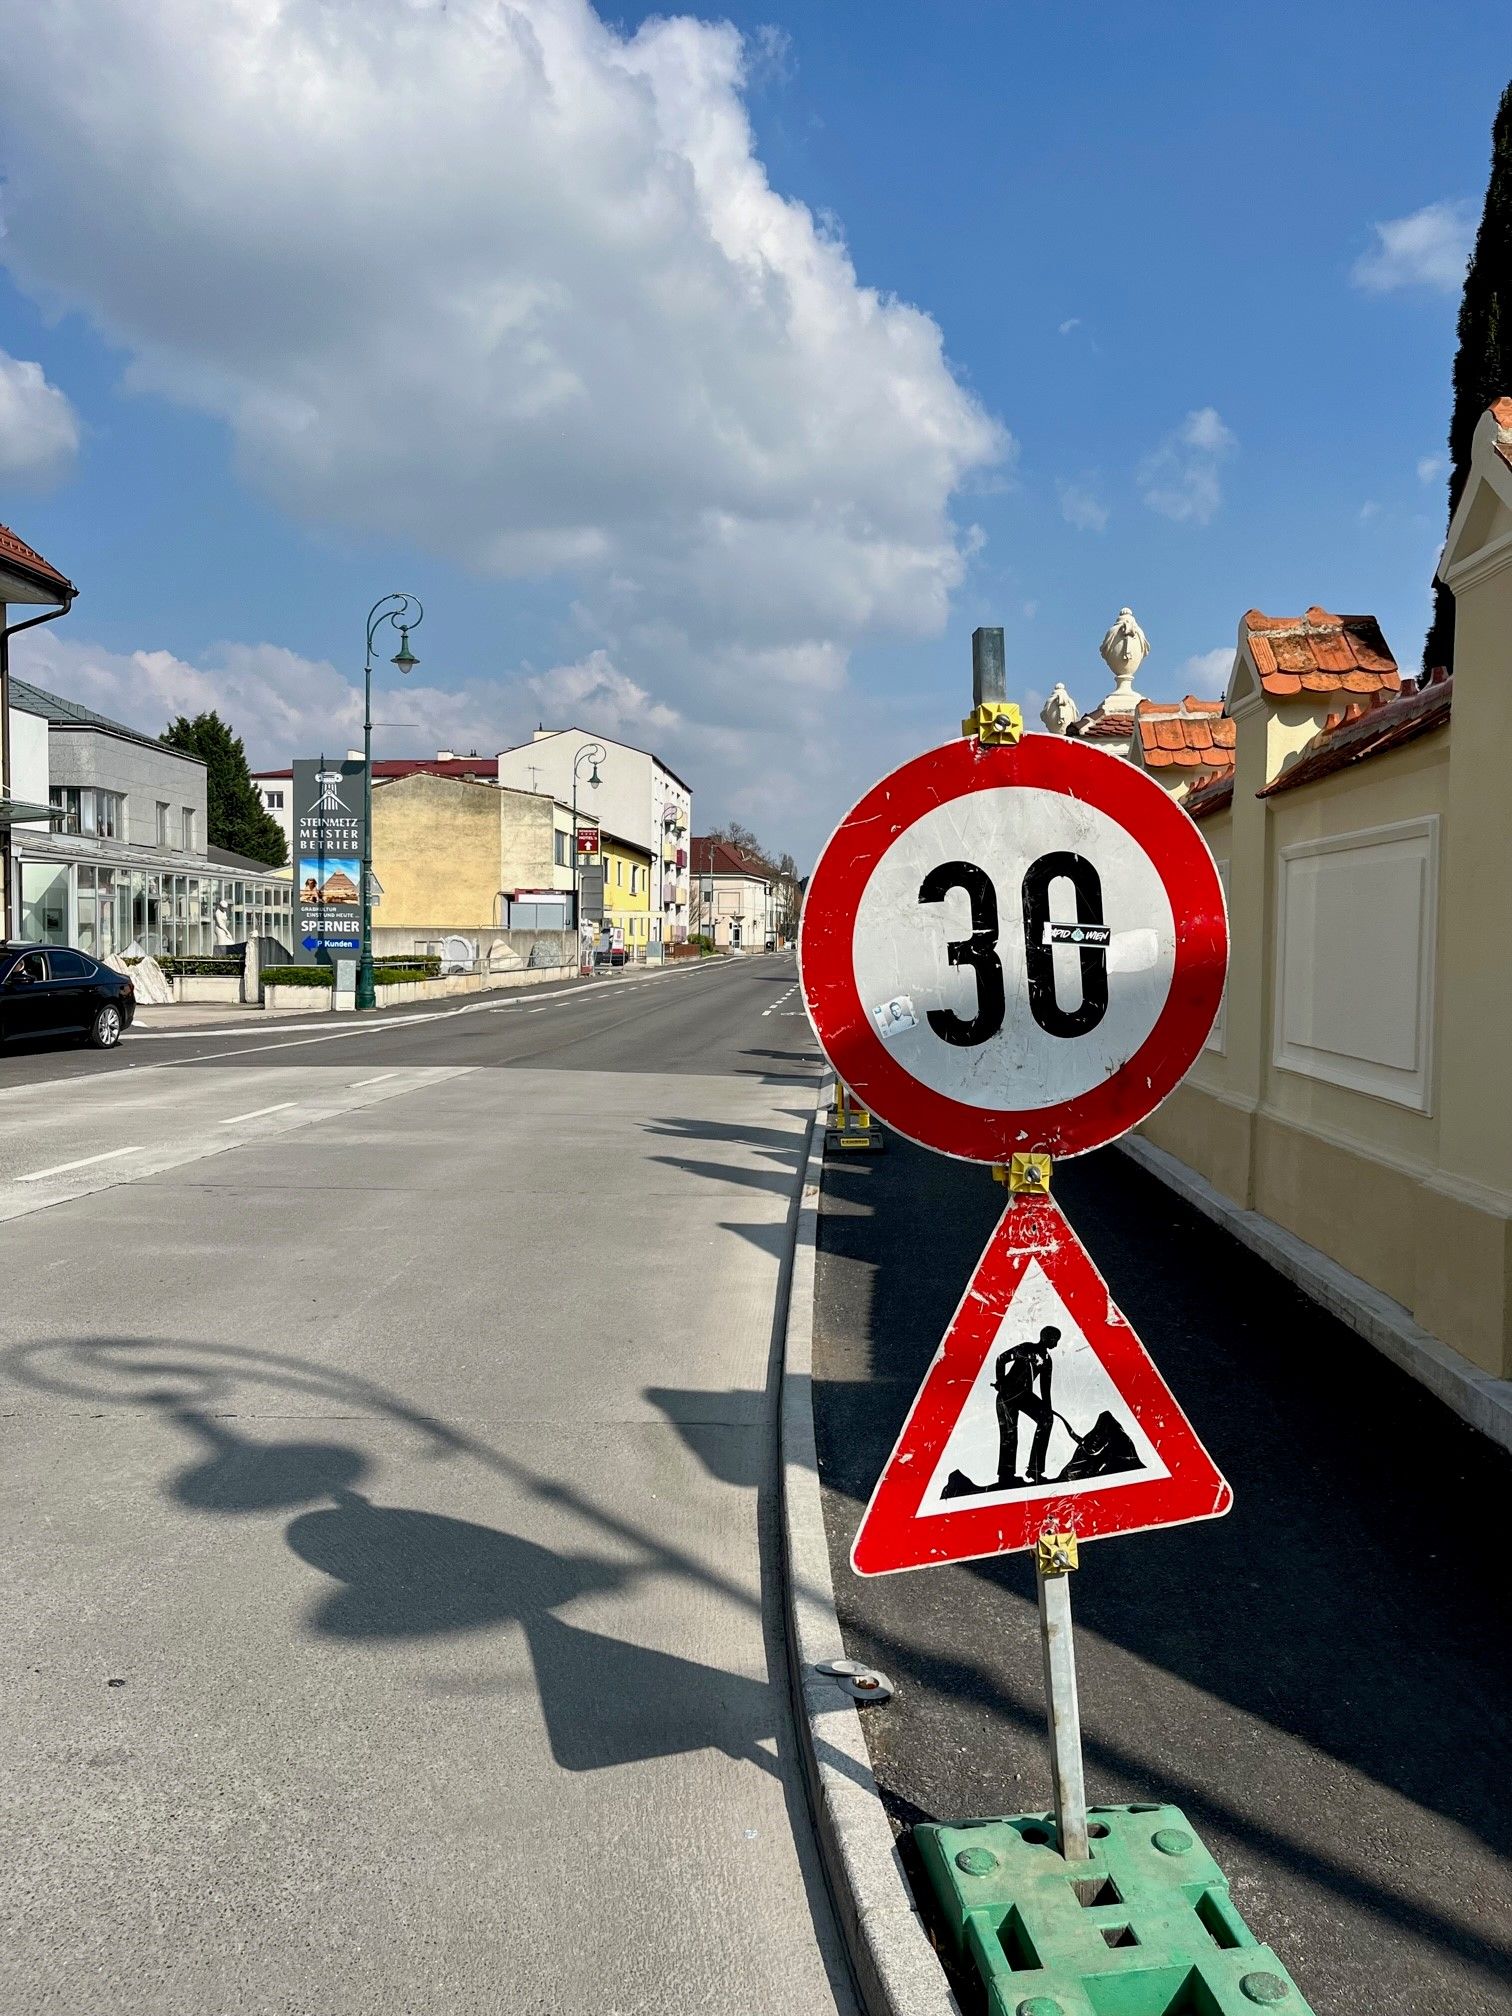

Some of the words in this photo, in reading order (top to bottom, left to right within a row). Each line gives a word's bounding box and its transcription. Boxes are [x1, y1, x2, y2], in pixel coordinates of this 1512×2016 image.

[300, 818, 358, 827] STEINMETZ
[300, 830, 358, 838] MEISTER
[300, 841, 358, 850] BETRIEB
[300, 921, 360, 932] SPERNER
[1048, 928, 1071, 938] APID
[1085, 931, 1109, 941] WIEN
[324, 940, 353, 948] Kunden
[918, 851, 1109, 1047] 30
